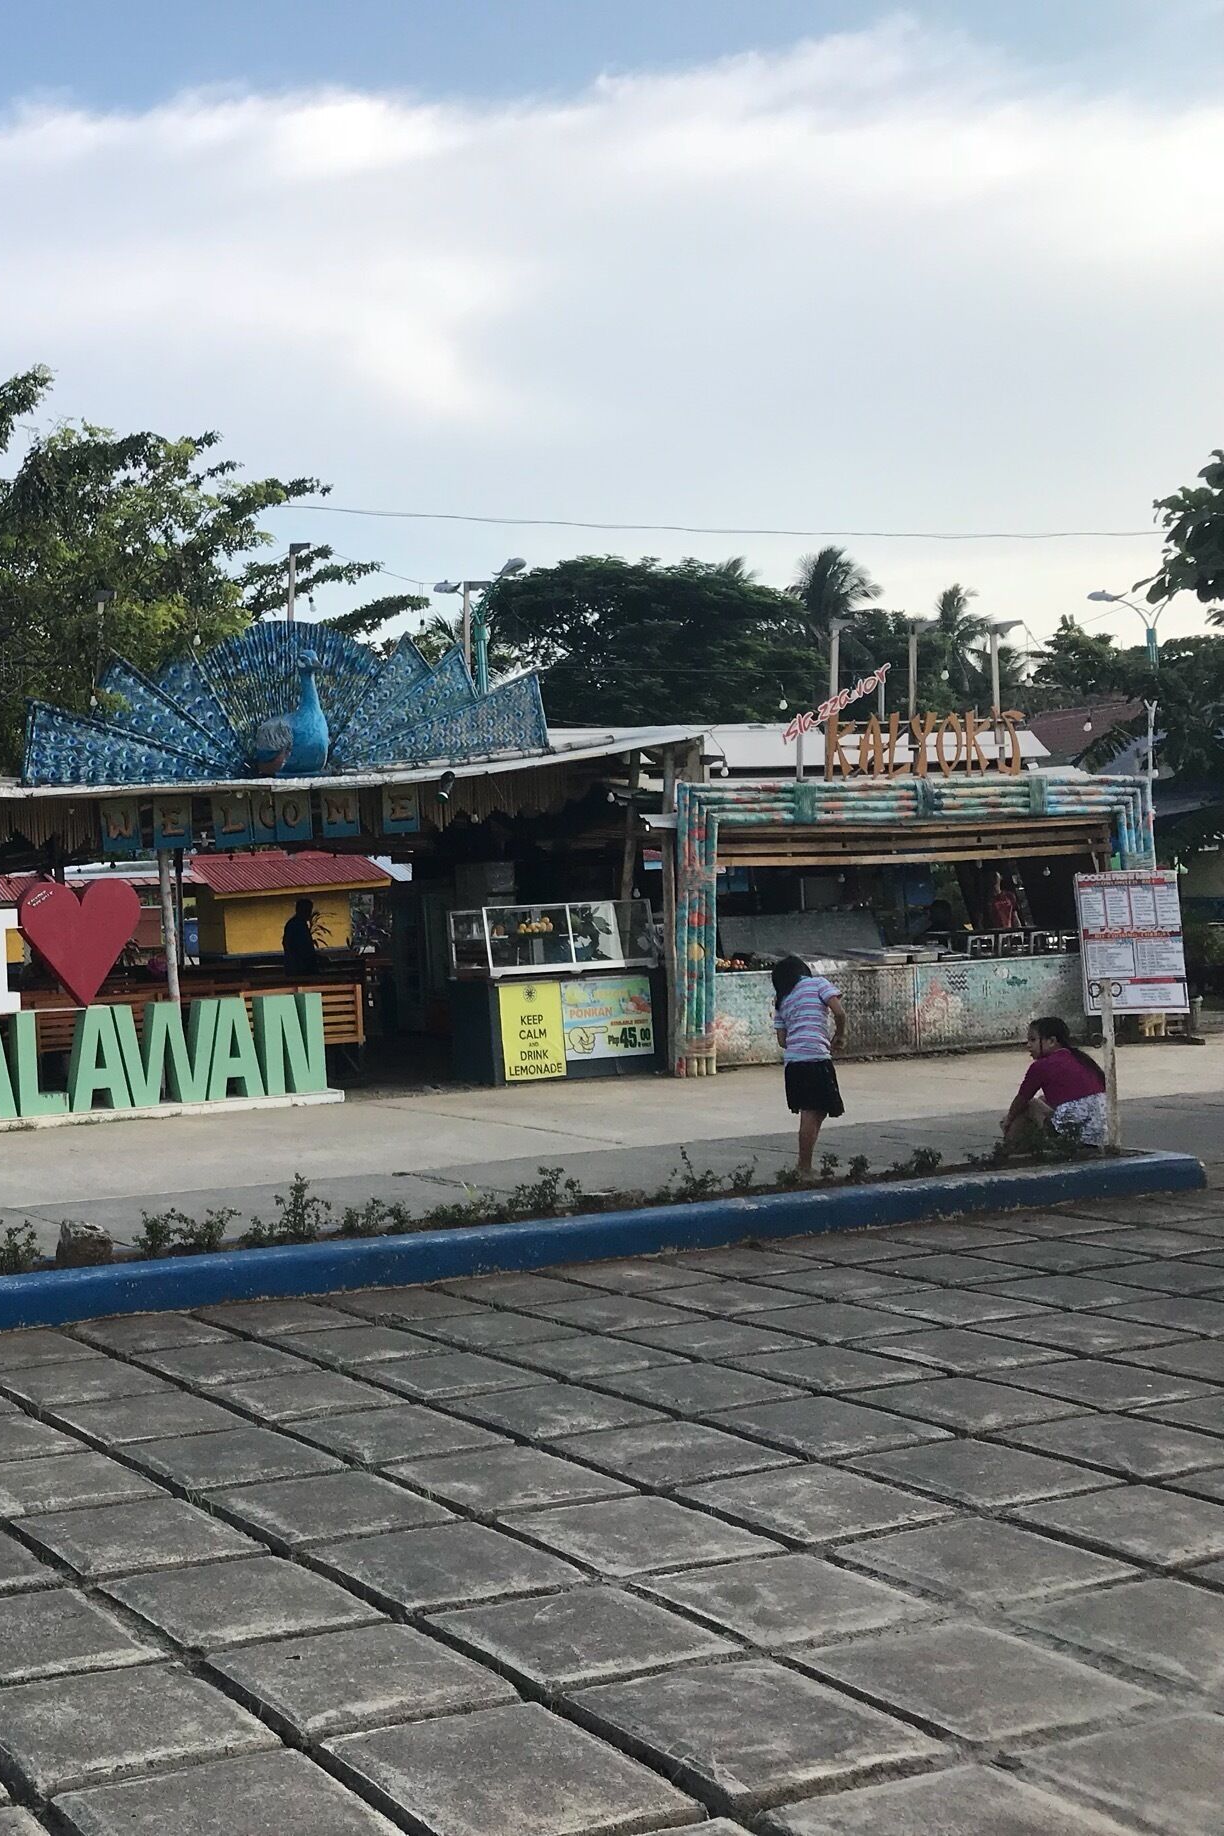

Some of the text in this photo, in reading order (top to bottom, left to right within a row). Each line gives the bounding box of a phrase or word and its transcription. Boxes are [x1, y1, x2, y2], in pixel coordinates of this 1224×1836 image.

[101, 793, 419, 841] WELCOME
[569, 1007, 613, 1019] PONKAN
[520, 1014, 544, 1026] KEEP
[519, 1029, 547, 1040] CALM
[520, 1050, 549, 1061] DRINK
[509, 1063, 563, 1076] LEMONADE
